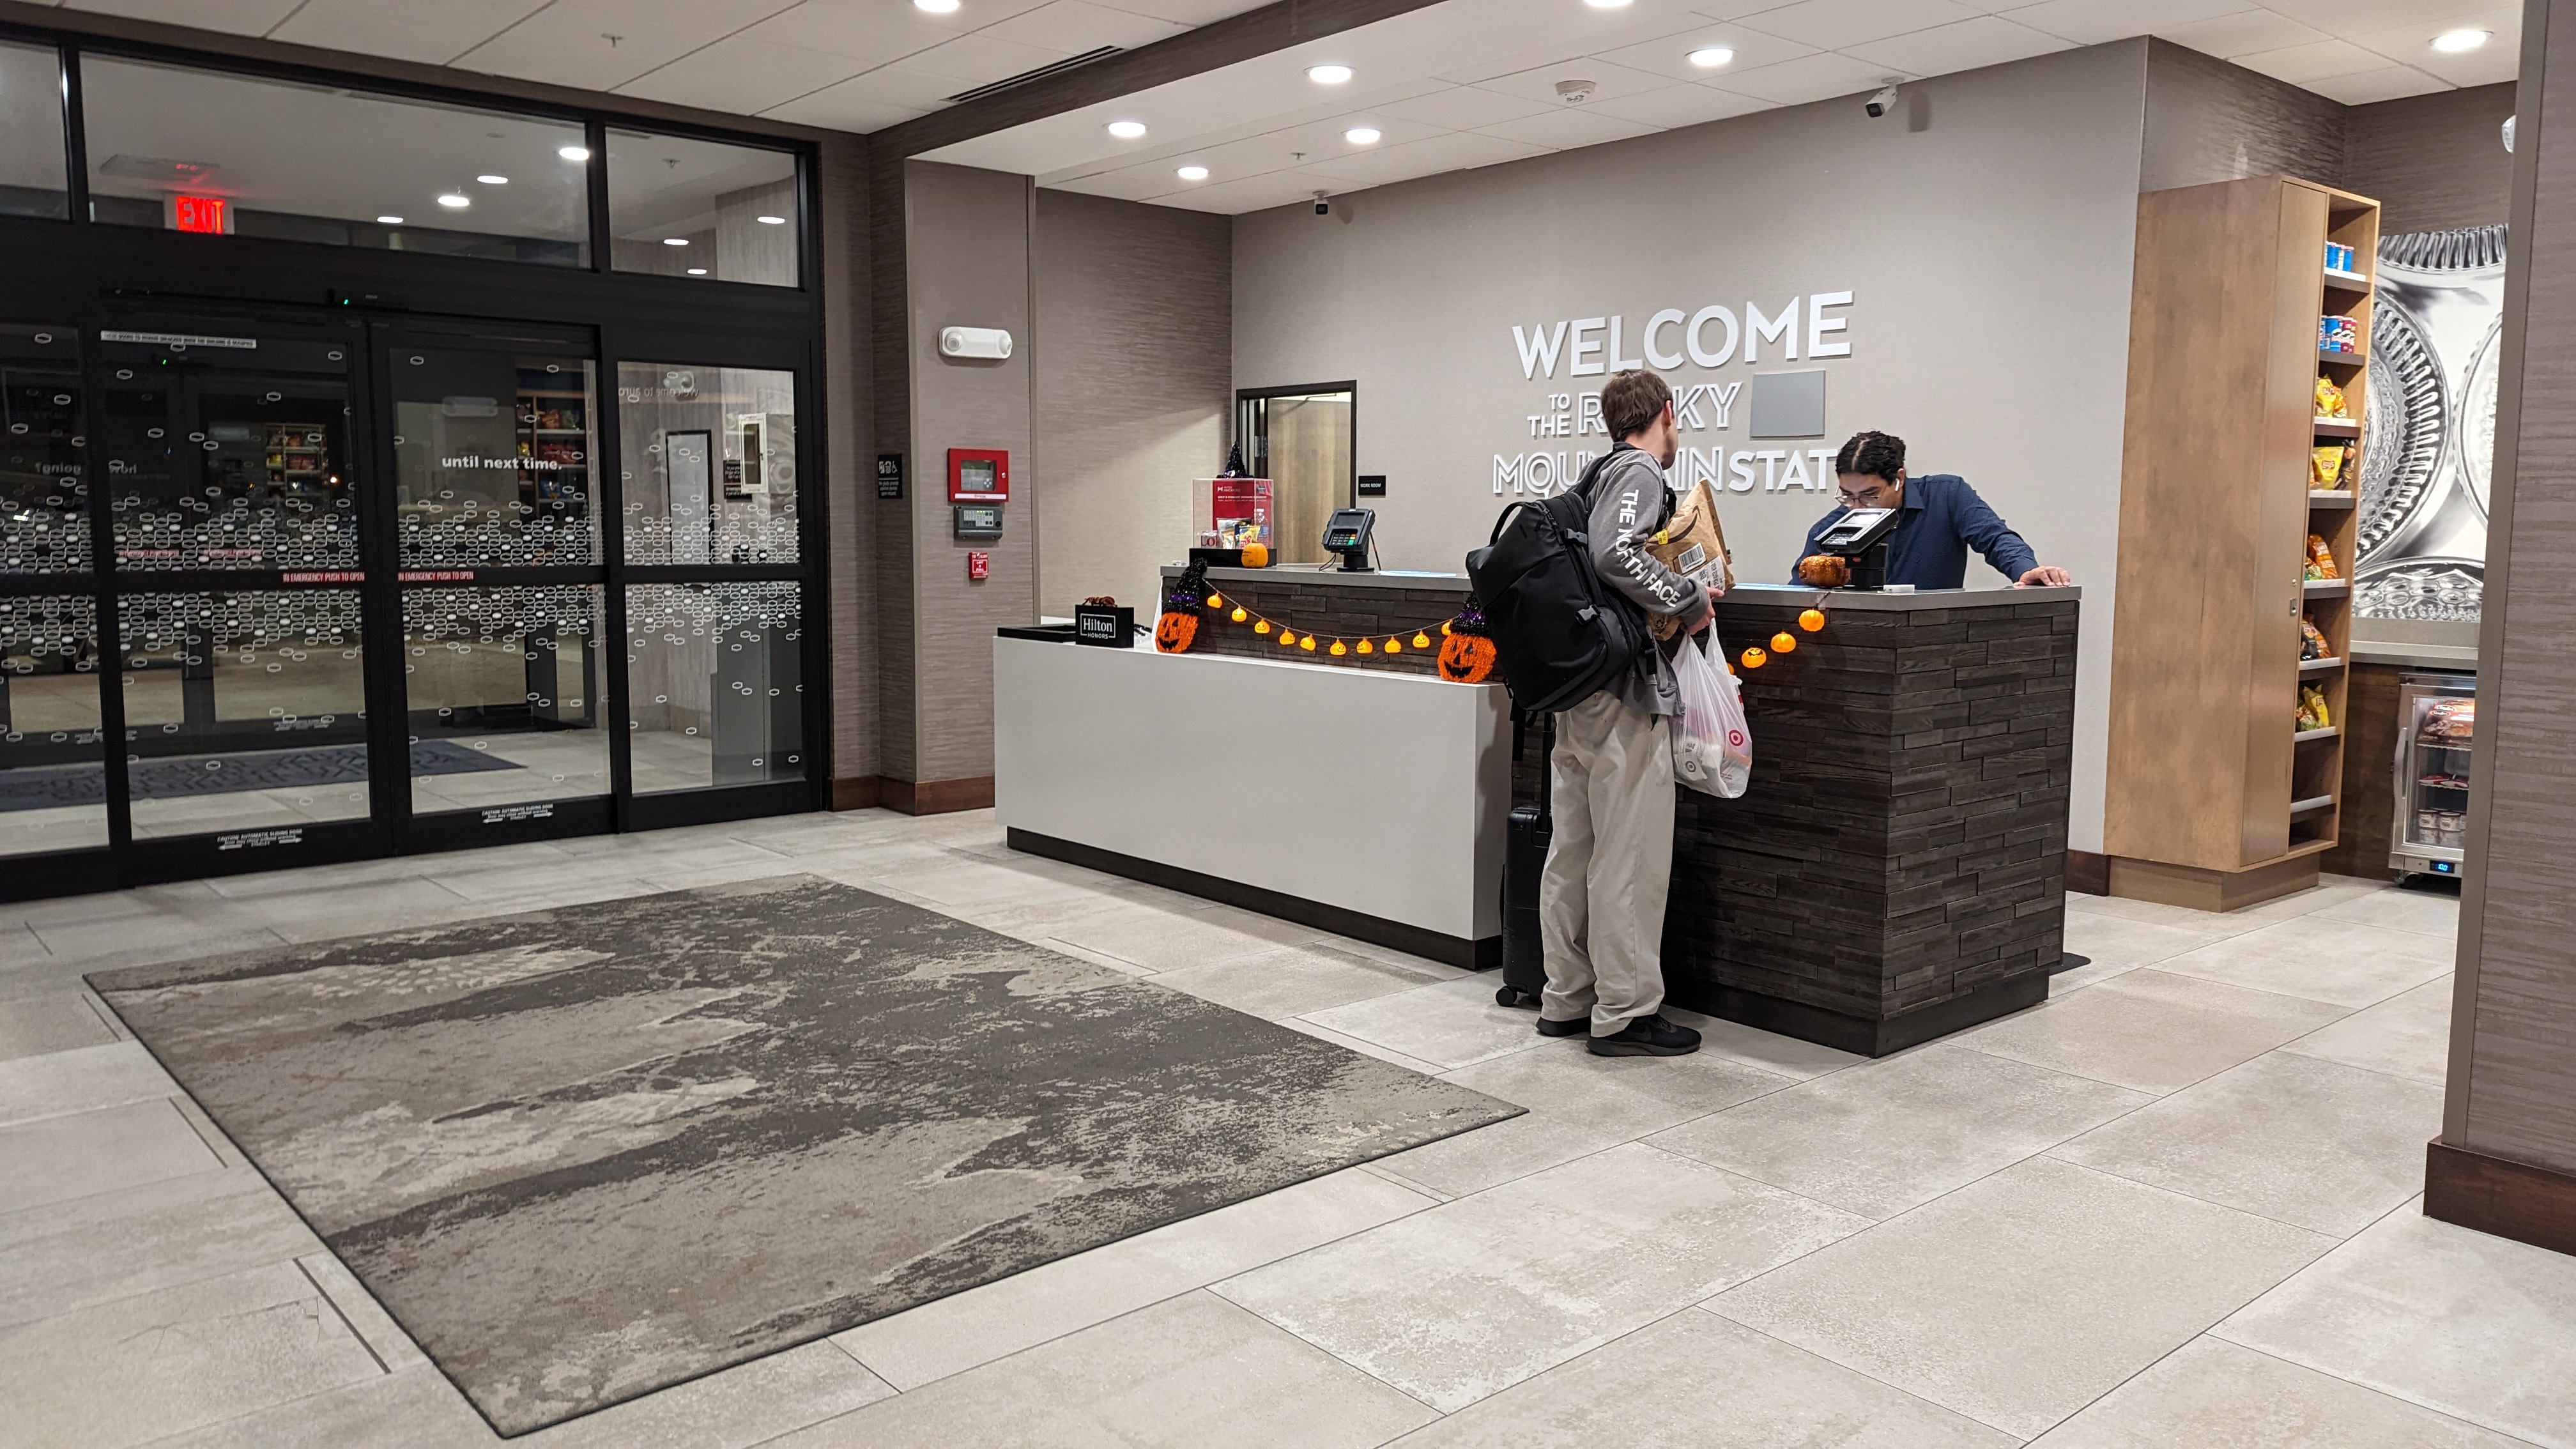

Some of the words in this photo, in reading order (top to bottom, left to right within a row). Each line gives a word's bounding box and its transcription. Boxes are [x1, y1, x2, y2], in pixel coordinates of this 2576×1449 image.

[176, 196, 224, 234] EXIT
[1512, 291, 1853, 379] WELCOME
[1527, 415, 1571, 436] THE
[1577, 382, 1742, 434] RKY
[1548, 394, 1571, 410] TO
[442, 456, 479, 468] until
[484, 457, 519, 470] next
[523, 457, 562, 470] time.
[1492, 446, 1723, 494] MOUIN
[1728, 449, 1838, 491] STAT
[1620, 489, 1639, 526] THE
[1615, 528, 1648, 581] NORTH
[290, 572, 324, 582] EMERGENCY
[325, 572, 340, 582] PUSH
[341, 572, 349, 581] TO
[349, 572, 365, 581] OPEN
[405, 572, 436, 581] EMERGENCY
[436, 571, 451, 581] PUSH
[452, 571, 459, 580] TO
[460, 571, 473, 580] OPEN
[1643, 573, 1681, 607] FACE
[1083, 618, 1112, 632] Hilton
